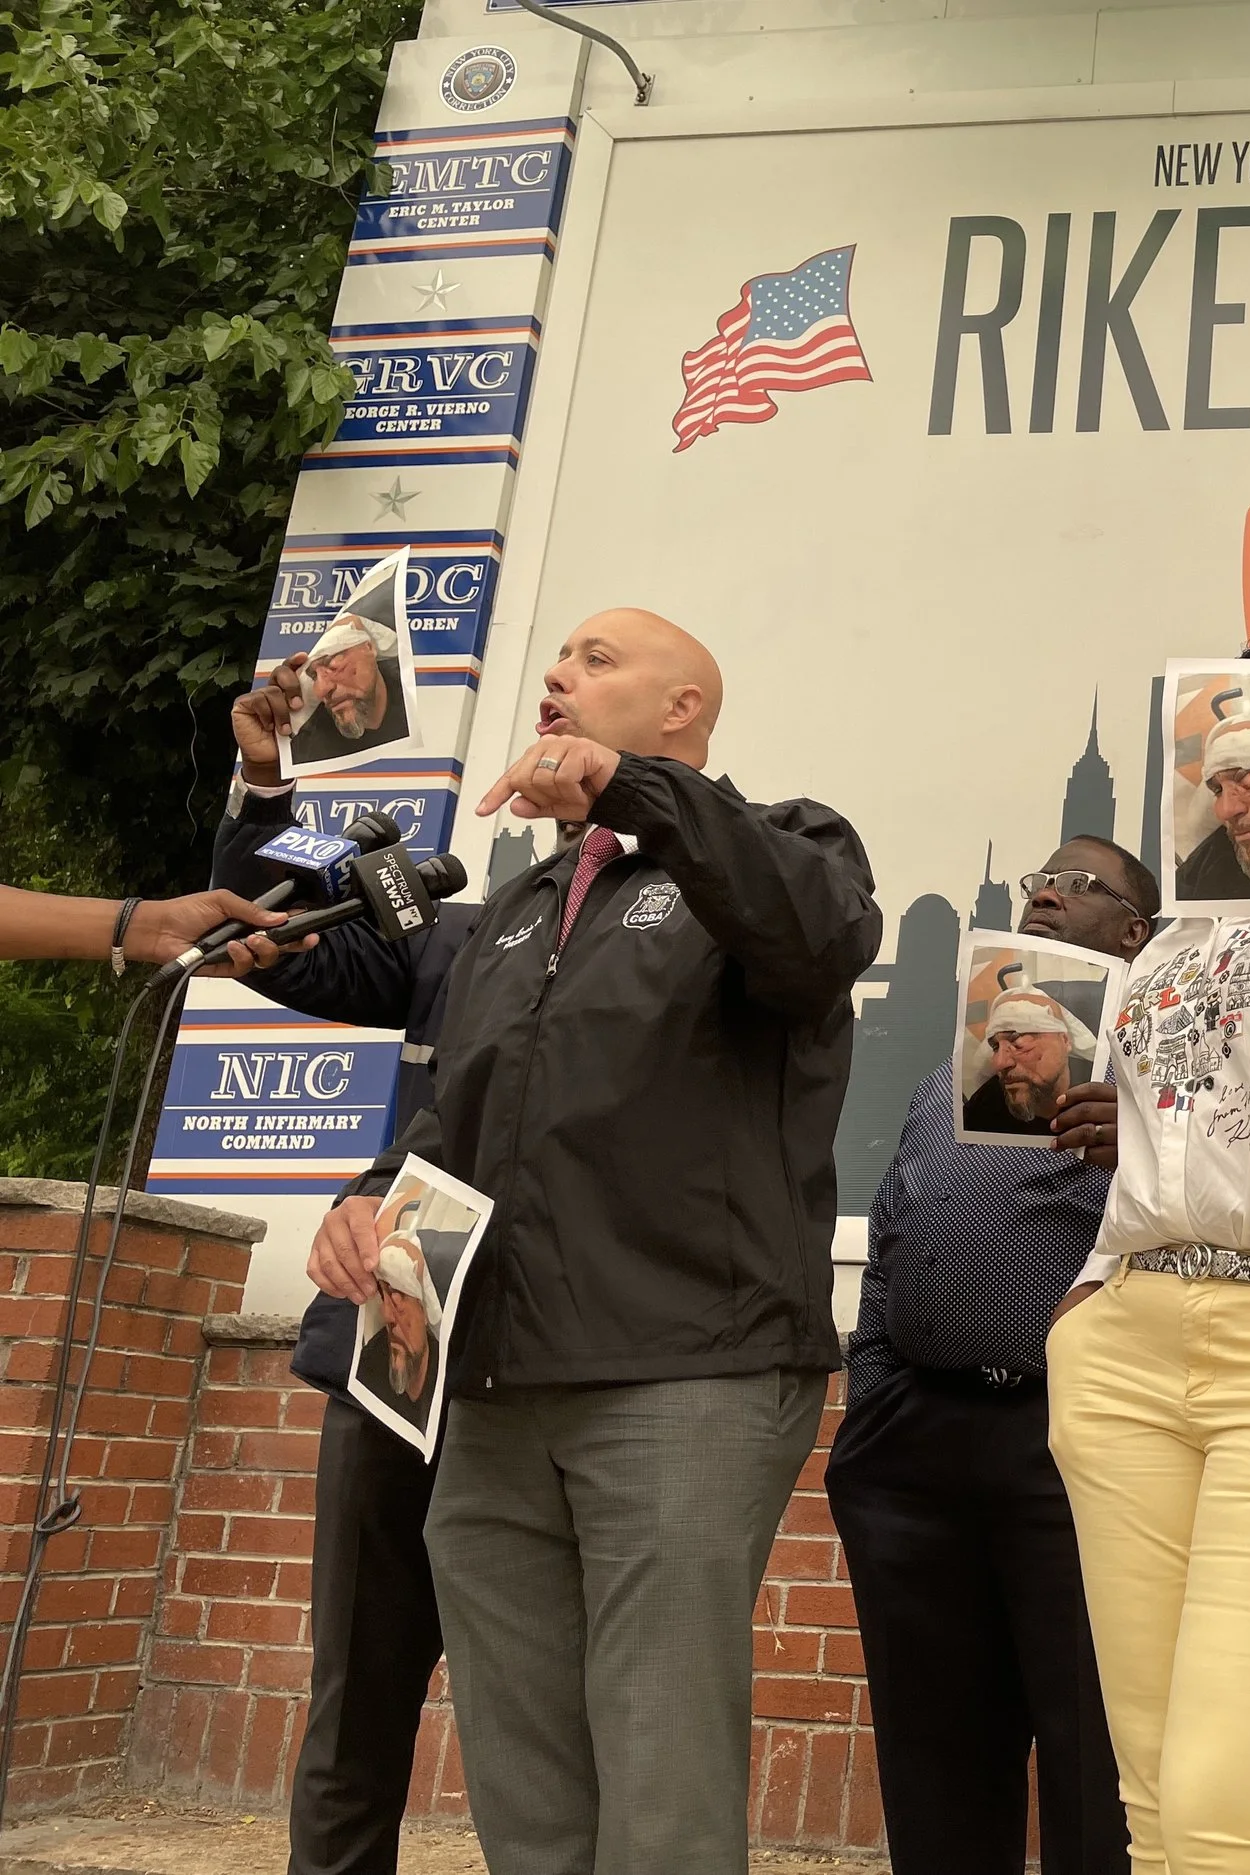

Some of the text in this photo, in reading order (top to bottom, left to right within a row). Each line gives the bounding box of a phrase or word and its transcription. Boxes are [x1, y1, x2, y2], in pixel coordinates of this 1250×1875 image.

[446, 55, 466, 77] NEW
[471, 48, 500, 57] YORK
[500, 53, 514, 74] CITY
[1155, 142, 1222, 187] NEW
[388, 198, 515, 219] ERIC M. TAYLOR
[417, 214, 481, 230] CENTER
[344, 401, 490, 420] EORGE R. VIERNO
[375, 418, 442, 433] CENTER
[408, 618, 459, 632] OREN
[376, 867, 405, 909] NEWS
[383, 853, 414, 905] SPECTRUM
[410, 907, 419, 919] NY
[629, 912, 663, 923] COBA
[210, 1051, 355, 1100] NIC
[182, 1114, 363, 1131] NORTH INFIRMARY
[221, 1133, 316, 1151] COMMAND
